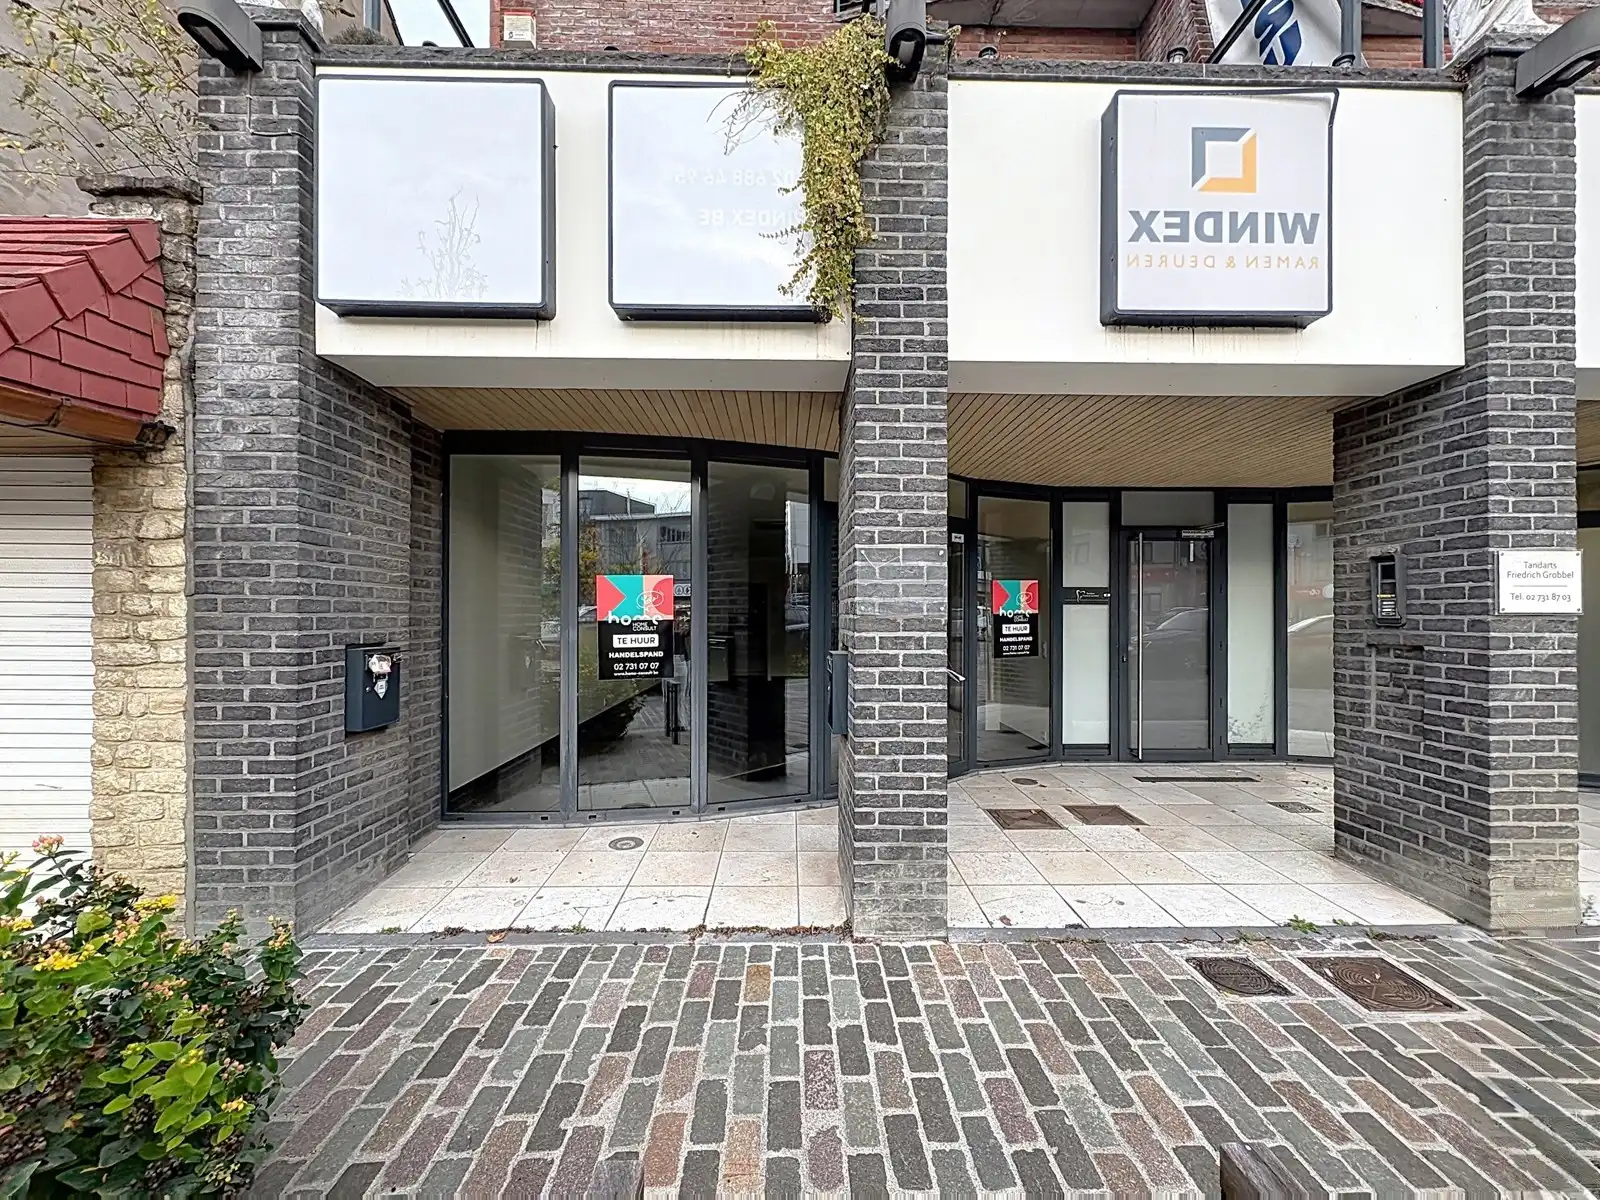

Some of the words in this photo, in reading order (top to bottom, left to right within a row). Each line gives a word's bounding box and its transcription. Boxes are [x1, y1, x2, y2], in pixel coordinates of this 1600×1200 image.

[1524, 561, 1557, 569] Tandarts
[1538, 594, 1549, 602] 731
[1552, 593, 1560, 602] 87
[1562, 594, 1571, 602] 03
[617, 637, 627, 645] TE
